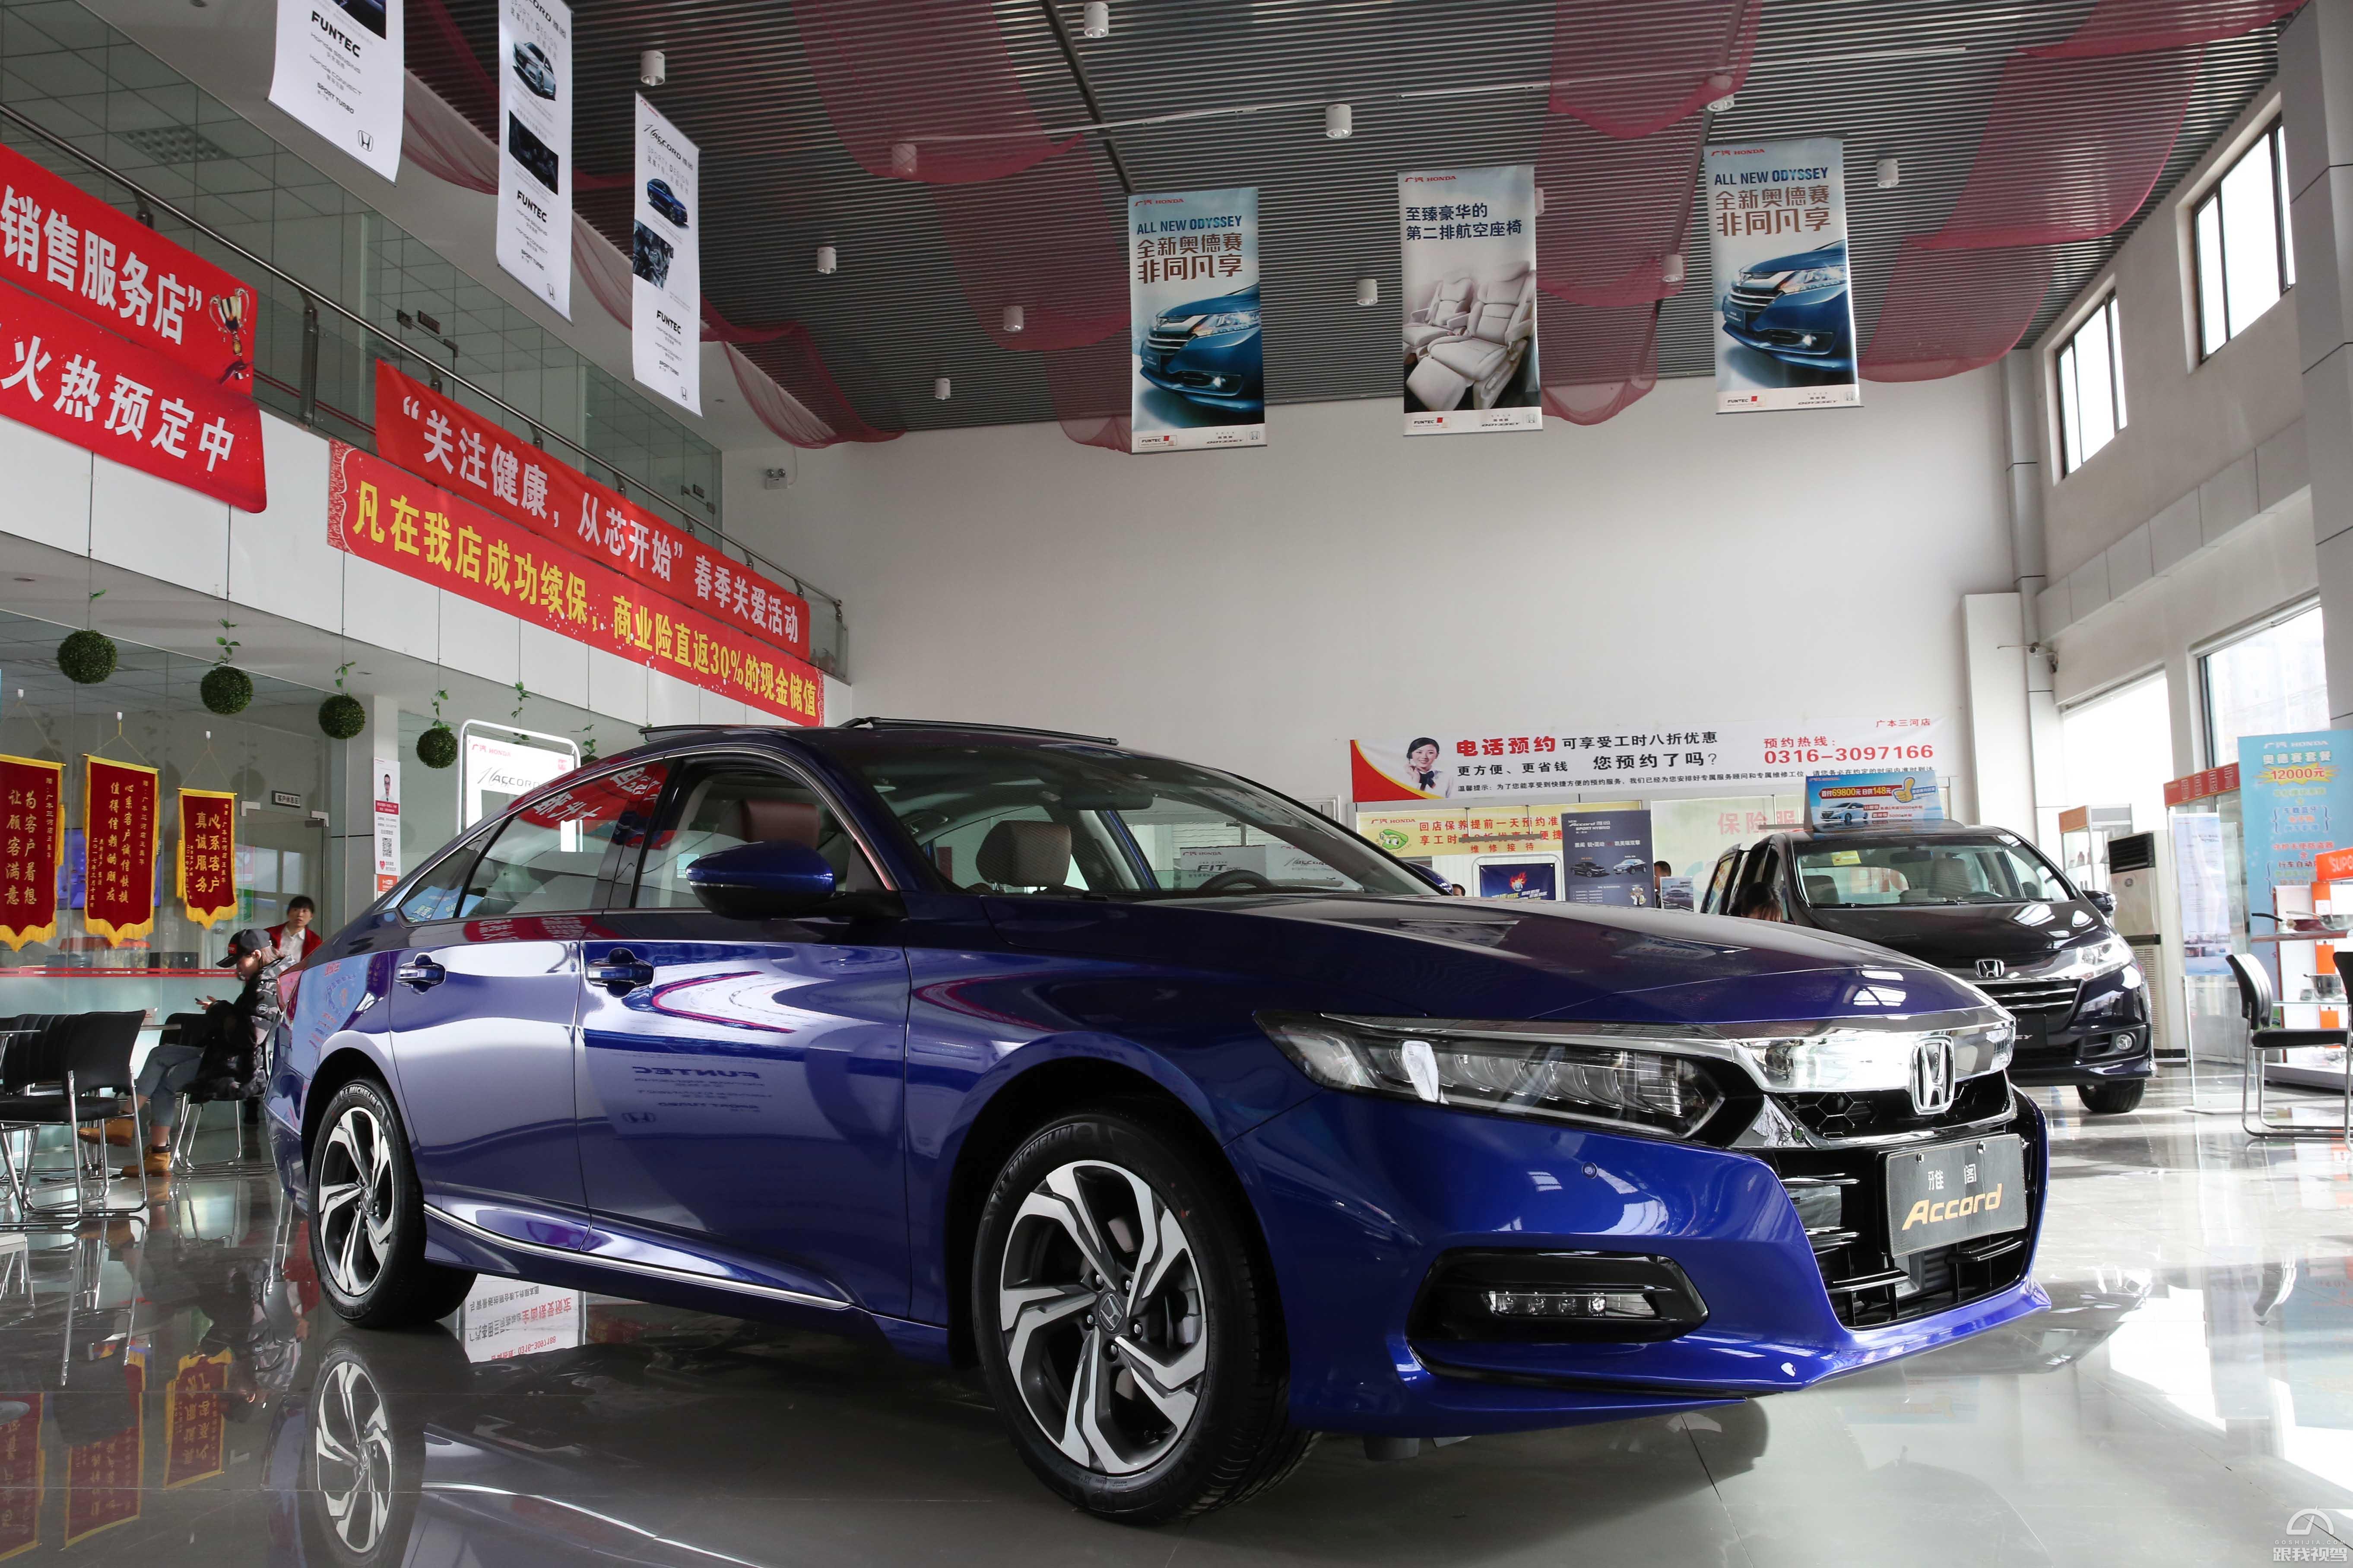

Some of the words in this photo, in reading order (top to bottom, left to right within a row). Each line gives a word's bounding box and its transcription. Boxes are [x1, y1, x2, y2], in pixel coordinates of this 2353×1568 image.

[311, 10, 361, 58] FUNTEC
[1715, 173, 1737, 185] ALL
[1741, 171, 1769, 184] NEW
[1772, 167, 1828, 182] ODYSSEY
[517, 190, 547, 223] FUNTEC
[1716, 185, 1830, 211] 全新奥德赛
[1137, 222, 1157, 235] ALL
[1161, 219, 1187, 232] NEW
[1189, 215, 1242, 230] ODYSSEY
[1405, 203, 1487, 222] 至臻豪华的
[1716, 207, 1831, 236] 非同凡享
[1406, 220, 1522, 241] 第二排航空座椅
[1137, 232, 1243, 259] 全新奥德赛
[1137, 253, 1243, 284] 非同凡享
[656, 310, 681, 334] FUNTEC
[0, 335, 234, 472] 火热预定中
[694, 554, 799, 644] 春季关爱活动
[1876, 719, 1931, 728] 广本三河店
[1457, 736, 1556, 757] 电话预约
[1562, 731, 1719, 750] 可享受工时八折优惠
[1764, 745, 1934, 765] 0316-3097166
[1457, 761, 1568, 776] 更方便、更省钱
[2271, 768, 2324, 780] 12000元
[1821, 787, 1861, 798] 首付69800元
[4, 789, 22, 905] 让顾客满意
[24, 790, 37, 905] 为客户着想
[106, 782, 120, 902] 值得信赖的朋友
[195, 811, 207, 893] 真诚服务
[208, 814, 221, 893] 心系客户
[1470, 843, 1534, 853] 维修接待
[349, 1086, 377, 1106] MICHELIN
[1008, 1127, 1072, 1182] MICHELIN
[1928, 1163, 1977, 1191] 雅阁
[1902, 1183, 2003, 1231] Accord
